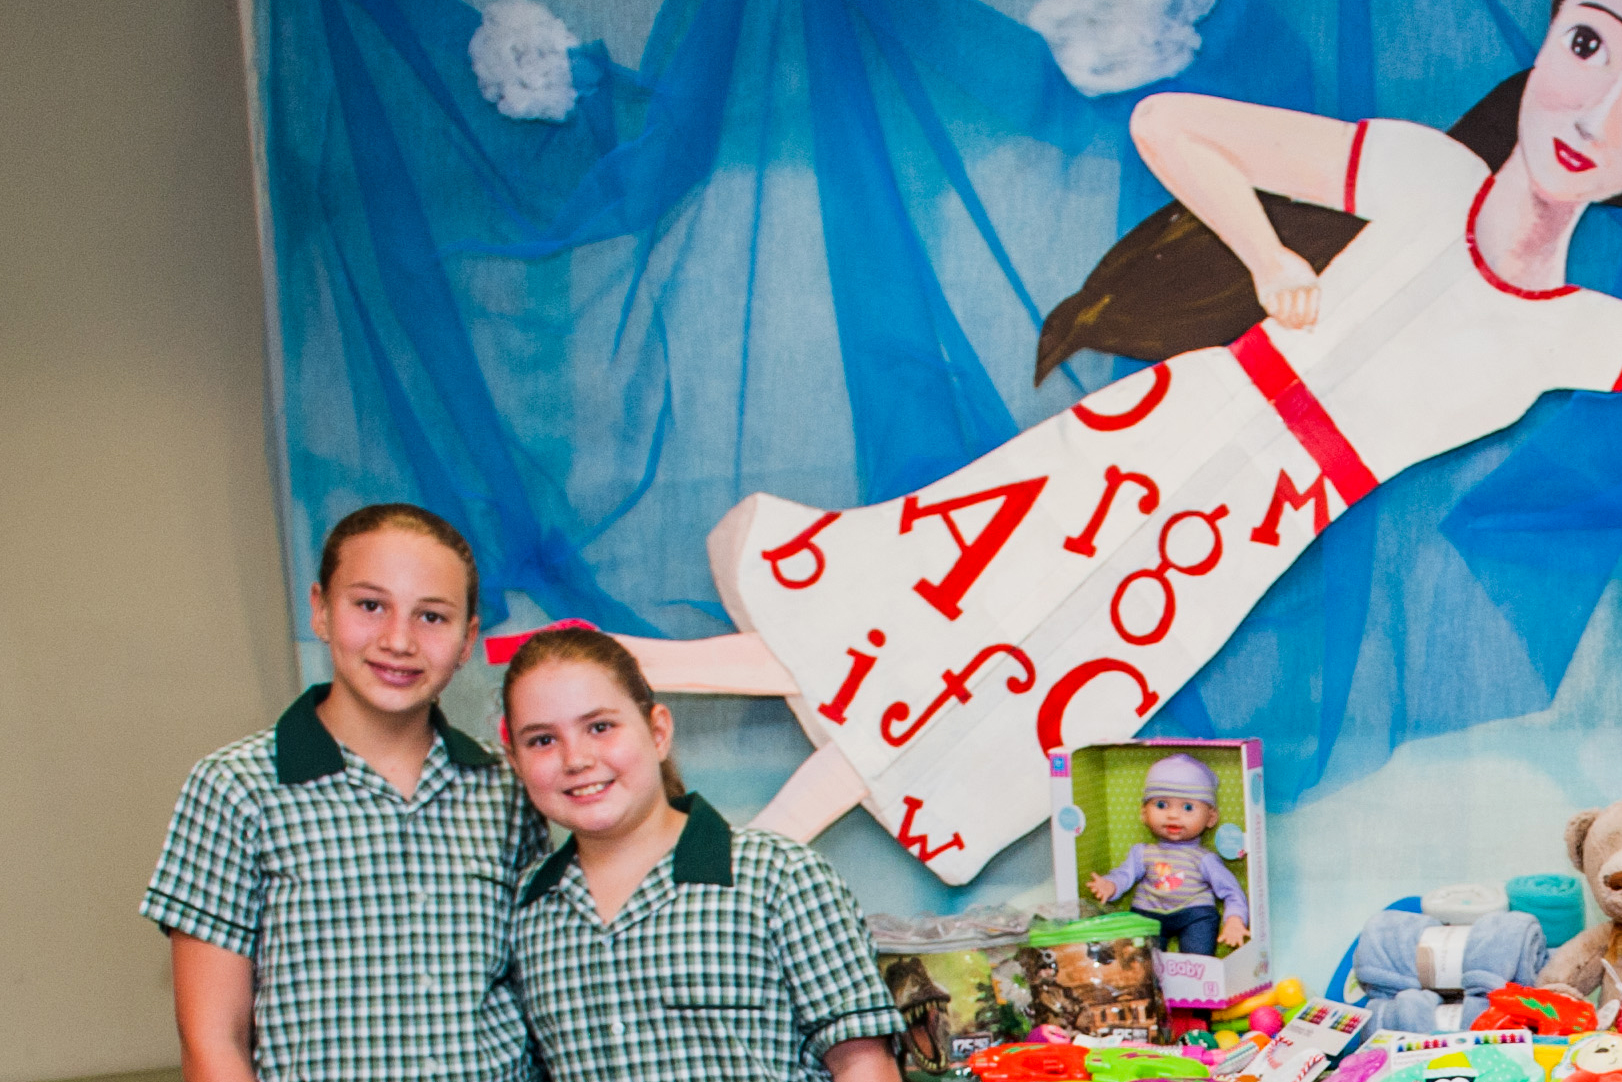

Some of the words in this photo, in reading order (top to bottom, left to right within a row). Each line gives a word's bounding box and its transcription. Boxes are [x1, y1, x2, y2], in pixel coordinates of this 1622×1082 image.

[900, 475, 1049, 621] A
[1063, 464, 1160, 557] r
[880, 643, 1036, 747] f
[1037, 658, 1160, 757] C
